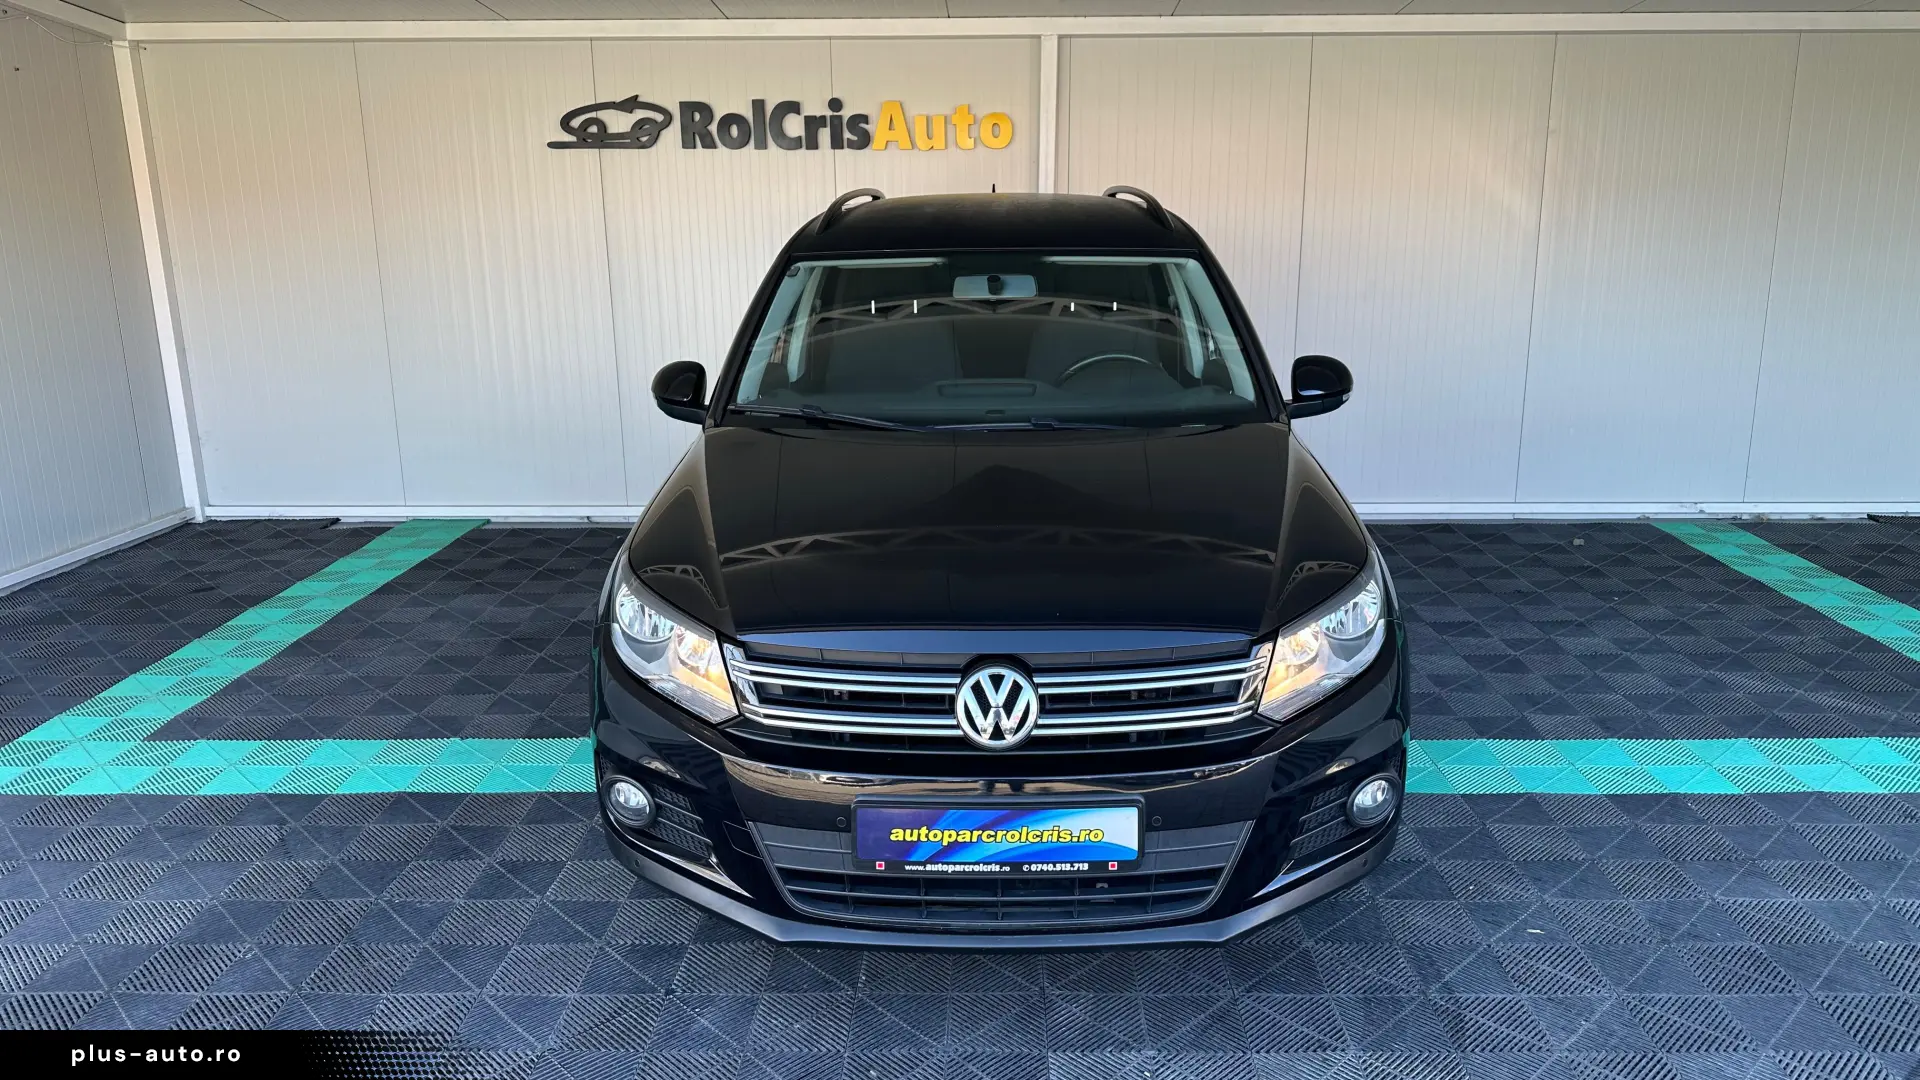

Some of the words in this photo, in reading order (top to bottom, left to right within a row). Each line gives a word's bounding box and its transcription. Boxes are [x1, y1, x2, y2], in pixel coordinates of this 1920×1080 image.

[678, 97, 1013, 150] RolCrisAuto
[889, 826, 1104, 846] autoparcrolcris.ro
[904, 862, 1010, 872] www.autoparcrolcris.ro
[1030, 862, 1088, 871] 0740.513.713
